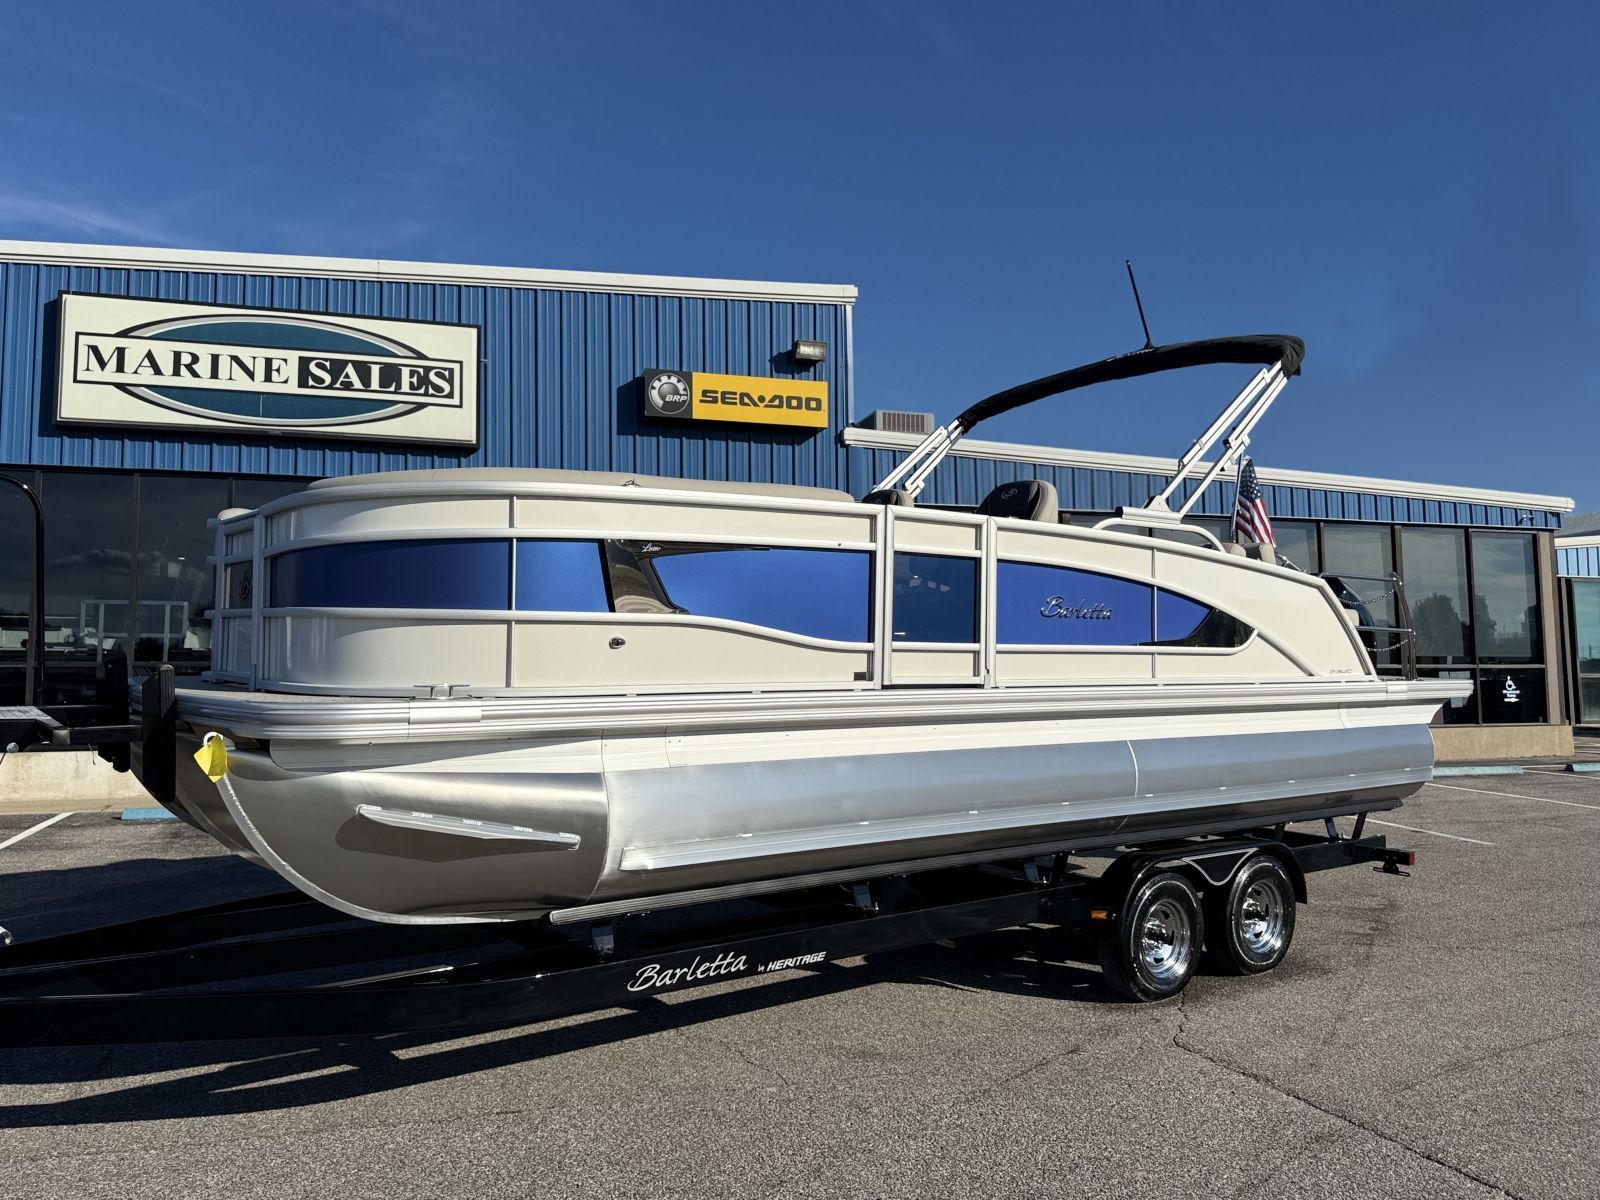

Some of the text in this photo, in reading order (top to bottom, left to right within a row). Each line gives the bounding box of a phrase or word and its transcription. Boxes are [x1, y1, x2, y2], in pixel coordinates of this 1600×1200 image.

[81, 343, 452, 398] MARINE SALES
[665, 394, 688, 403] BRP
[1040, 596, 1113, 620] Barletta
[627, 951, 748, 992] Barletta
[766, 951, 827, 972] HERITAGE
